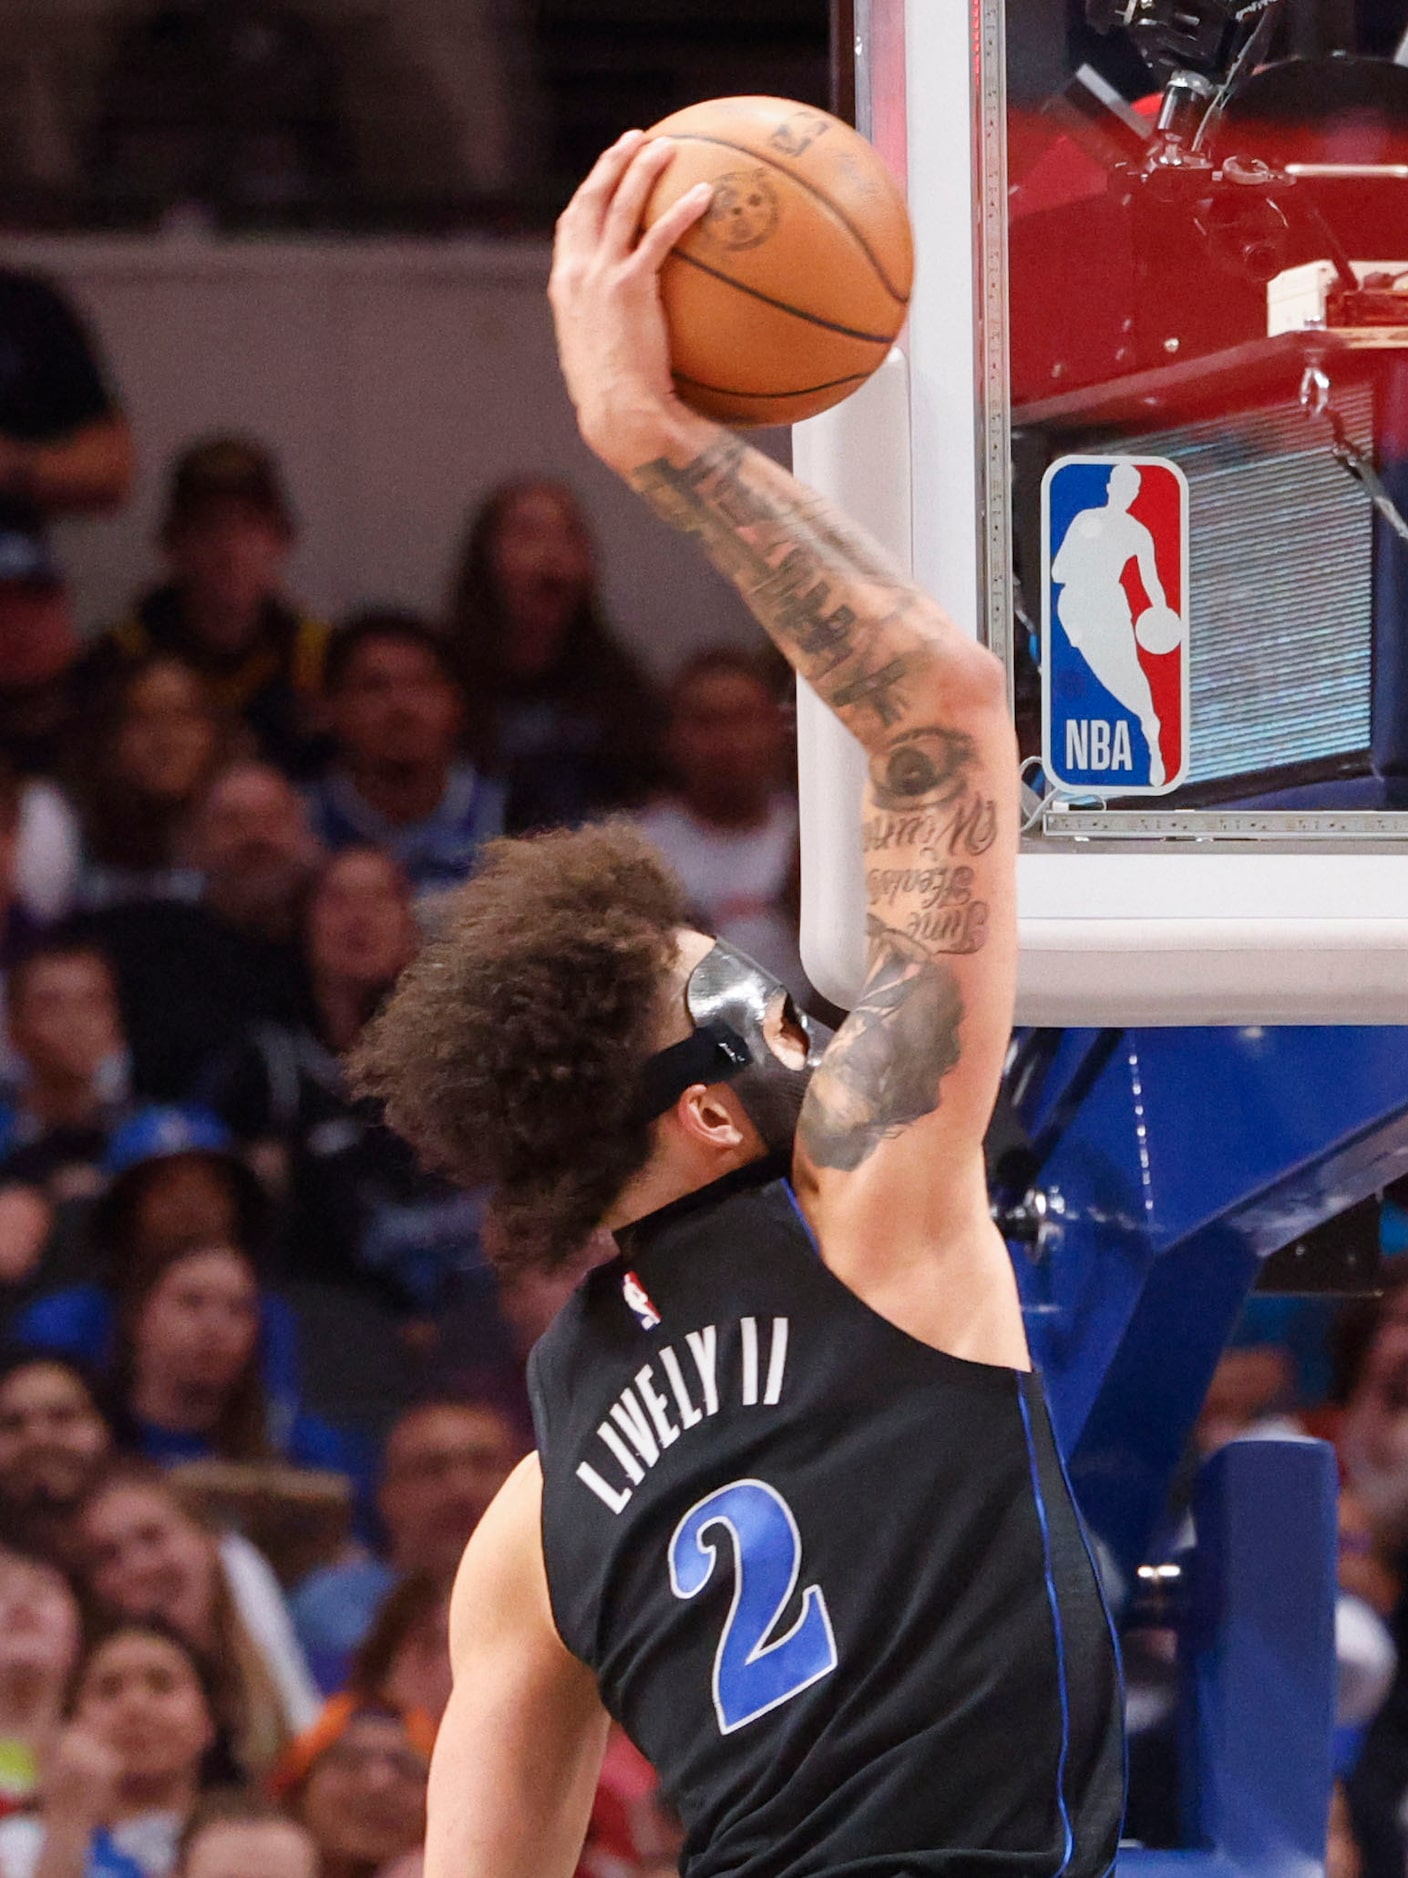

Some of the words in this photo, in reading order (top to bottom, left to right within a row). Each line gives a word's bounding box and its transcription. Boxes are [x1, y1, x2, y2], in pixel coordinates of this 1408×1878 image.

[1065, 719, 1133, 771] NBA
[575, 1324, 720, 1515] LIVELY
[740, 1316, 789, 1406] II
[667, 1478, 838, 1736] 2
